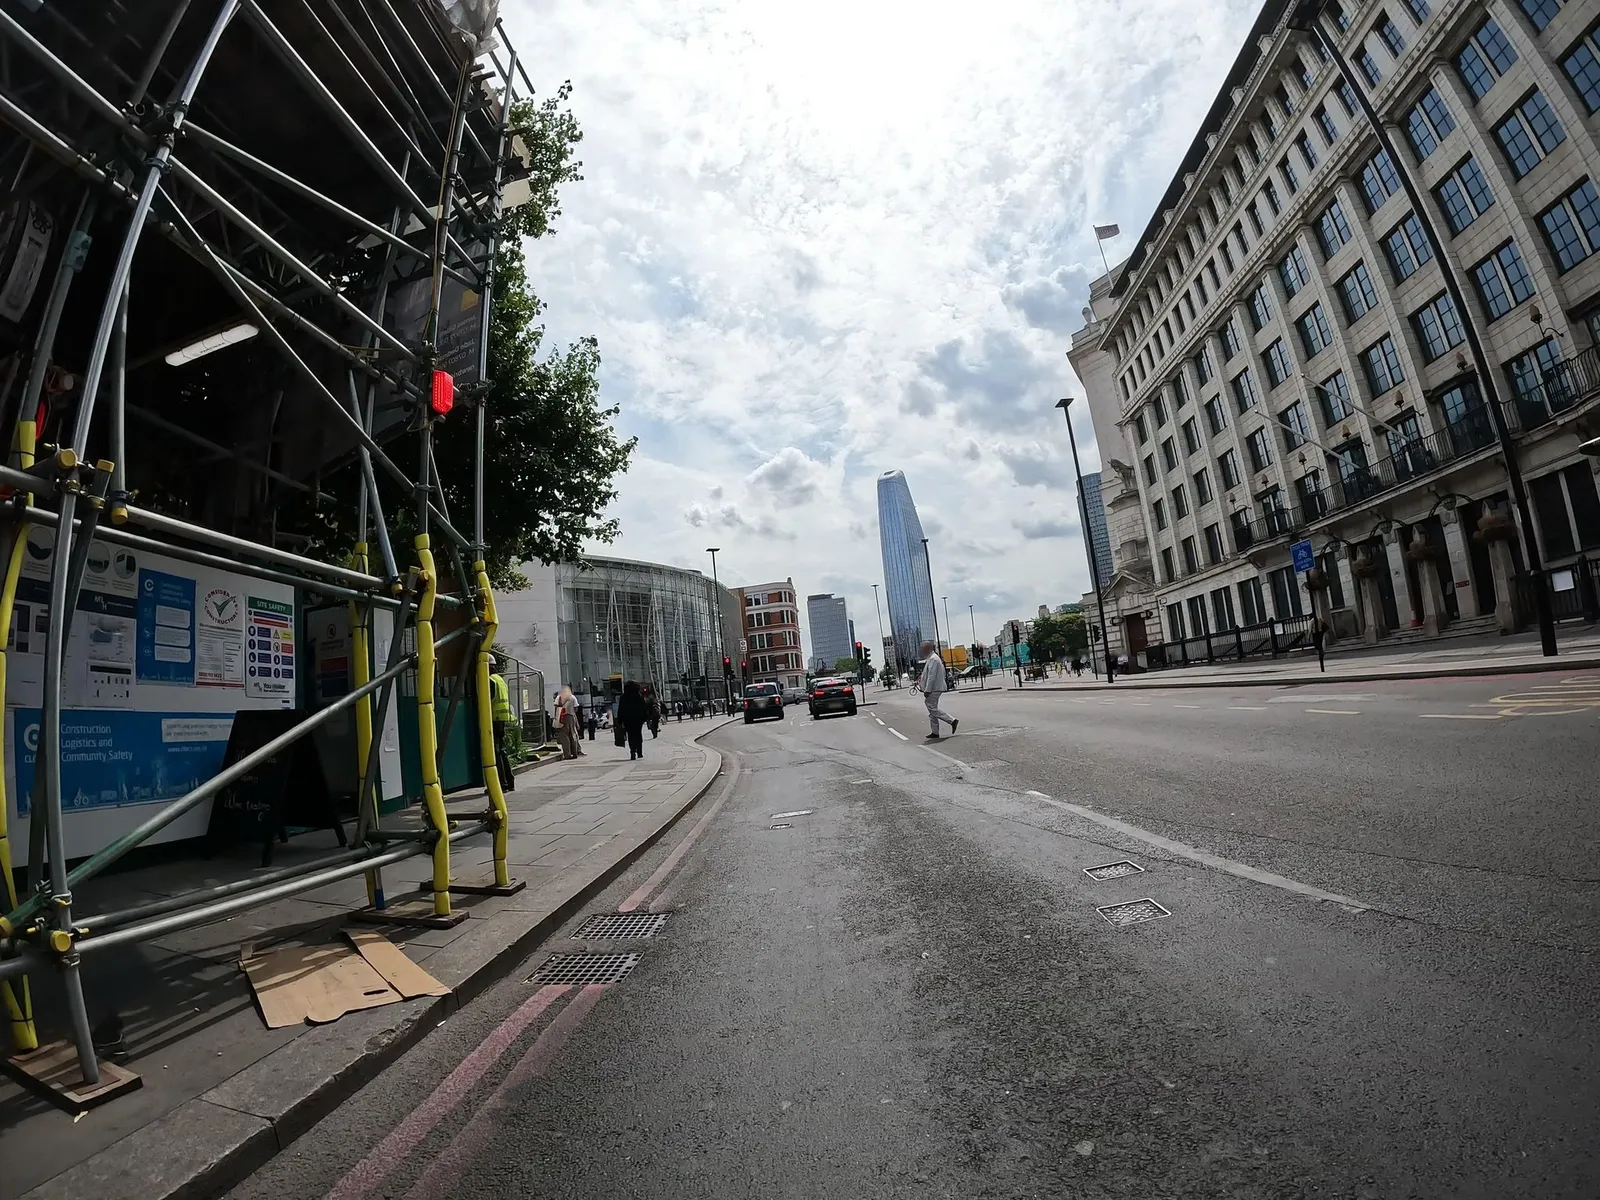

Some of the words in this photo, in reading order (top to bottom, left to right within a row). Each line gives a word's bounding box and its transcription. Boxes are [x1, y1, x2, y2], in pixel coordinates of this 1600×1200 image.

[257, 600, 268, 609] SITE
[268, 603, 286, 612] SAFETY
[60, 723, 111, 735] Construction
[60, 736, 96, 749] Logistics
[98, 736, 113, 747] and
[61, 750, 108, 764] Community
[108, 750, 133, 762] Safety
